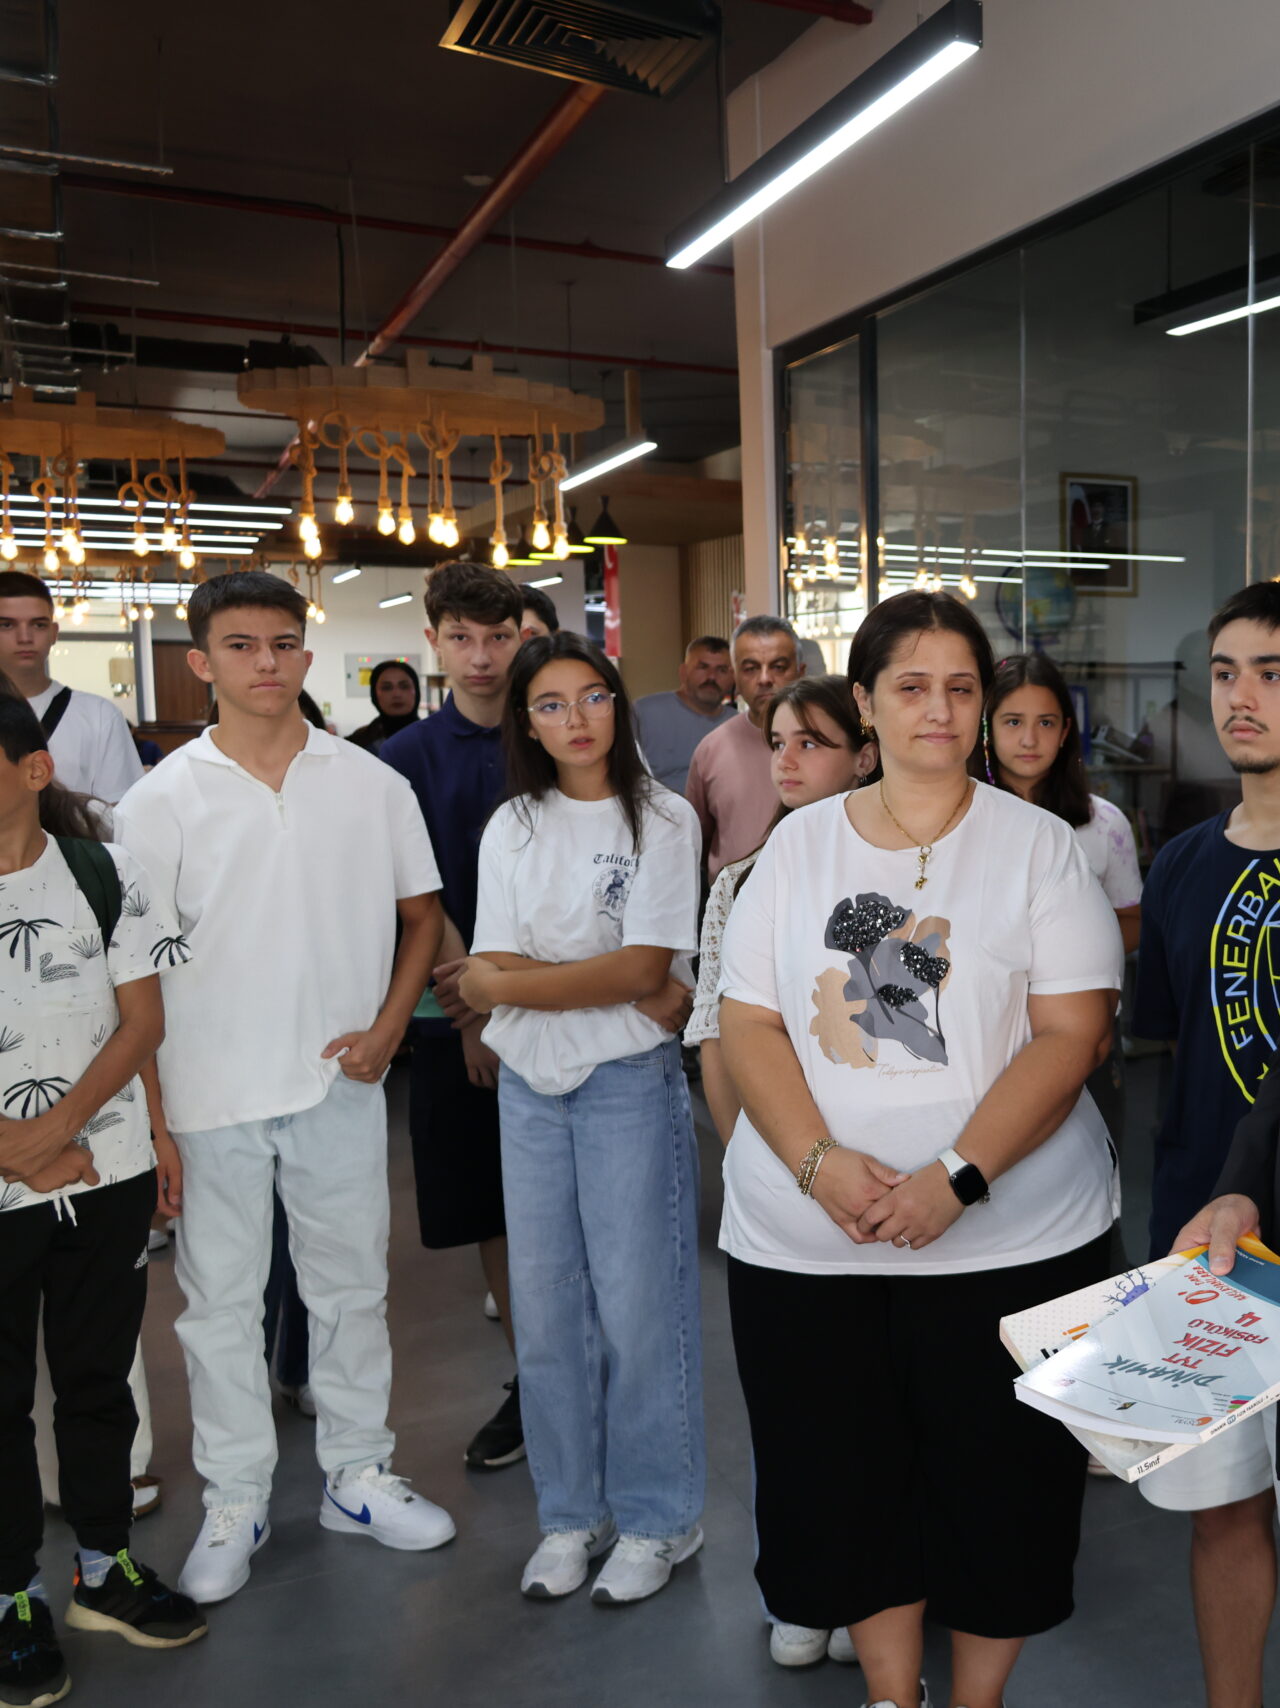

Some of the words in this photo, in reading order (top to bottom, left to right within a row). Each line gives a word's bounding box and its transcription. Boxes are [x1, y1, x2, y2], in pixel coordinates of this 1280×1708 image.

[1234, 1312, 1262, 1327] 4
[1173, 1333, 1241, 1357] FİZİK
[1101, 1354, 1226, 1387] DİNAMİK
[1161, 1353, 1203, 1369] TYT
